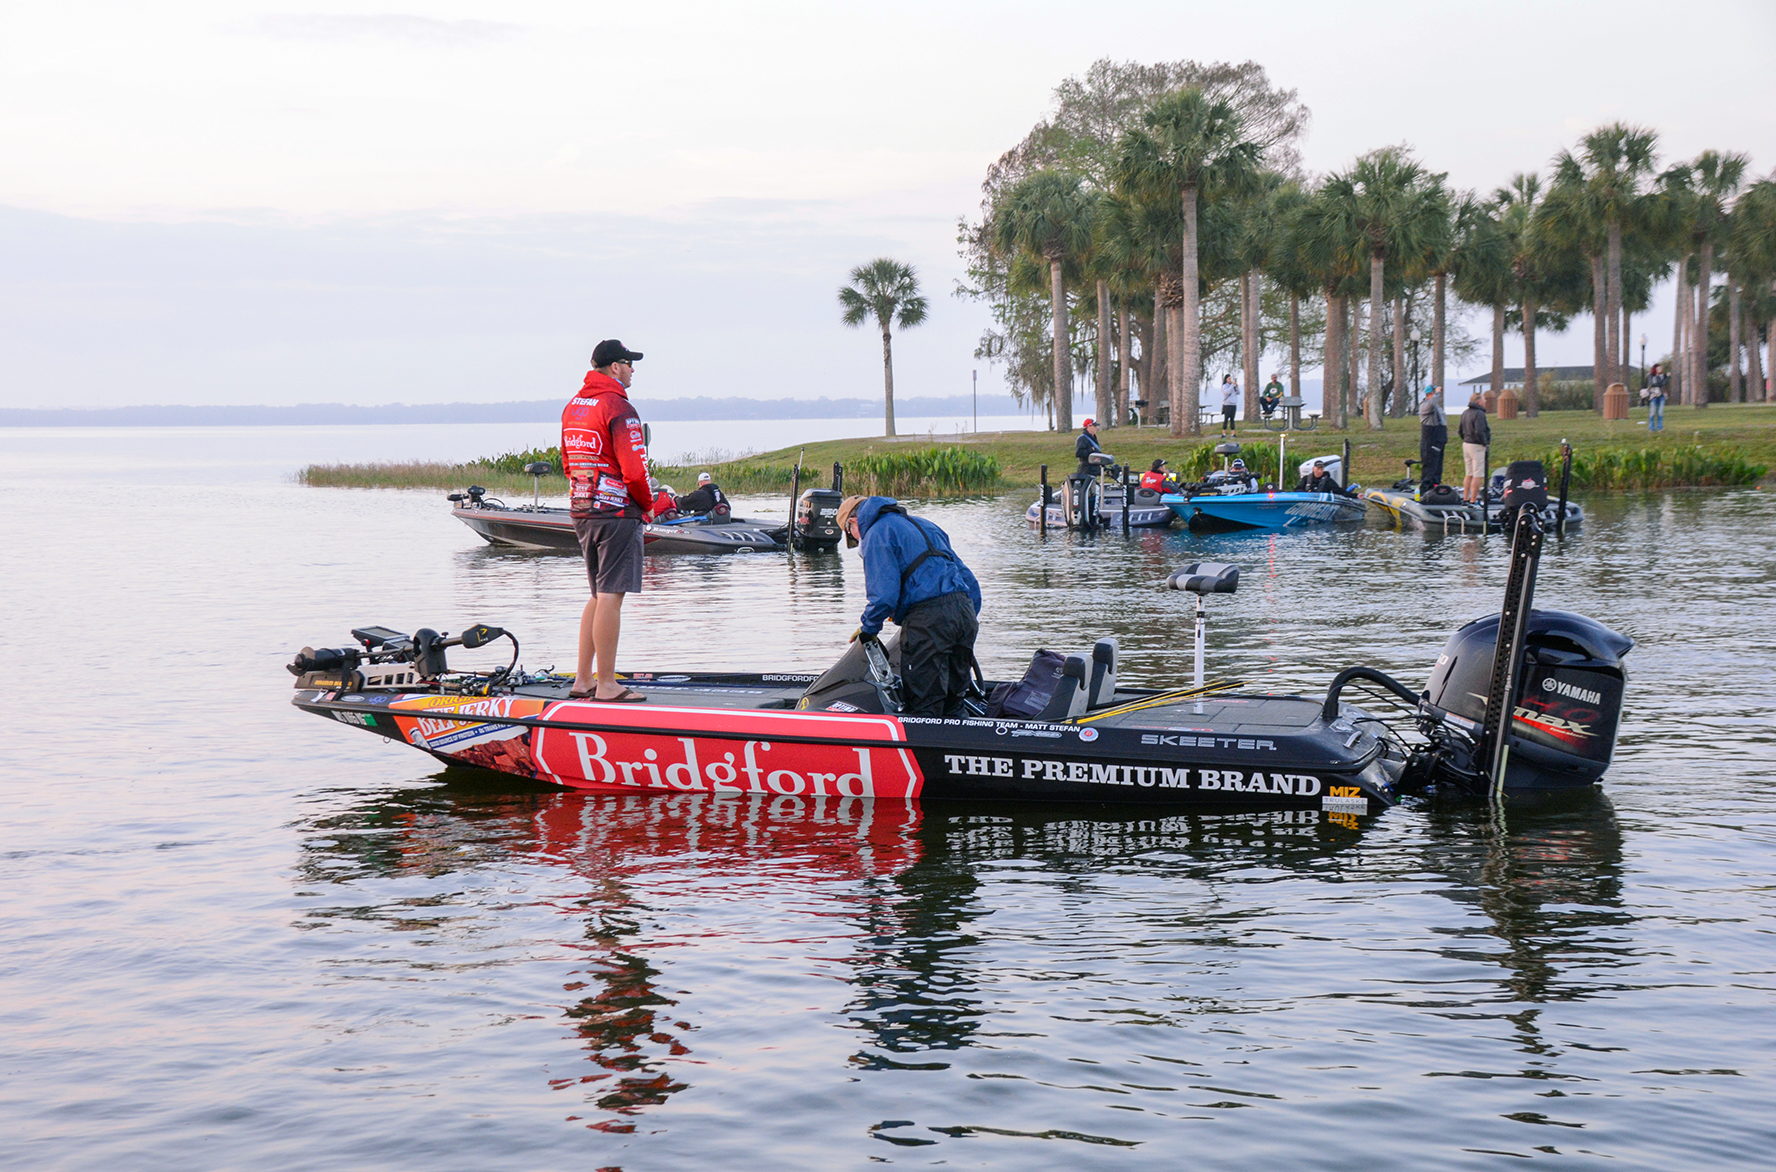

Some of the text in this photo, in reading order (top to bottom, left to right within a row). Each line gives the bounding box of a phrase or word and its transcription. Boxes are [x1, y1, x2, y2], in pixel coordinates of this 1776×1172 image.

[571, 397, 599, 406] STEFAN
[1557, 681, 1602, 705] YAMAHA
[897, 717, 942, 725] BRIDGFORD
[996, 721, 1018, 729] TEAM
[1049, 724, 1081, 732] STEFAN
[1140, 734, 1277, 751] SKEETER
[568, 731, 875, 798] Bridgford
[944, 755, 1322, 796] THE PREMIUM BRAND
[1329, 785, 1361, 798] MIZ
